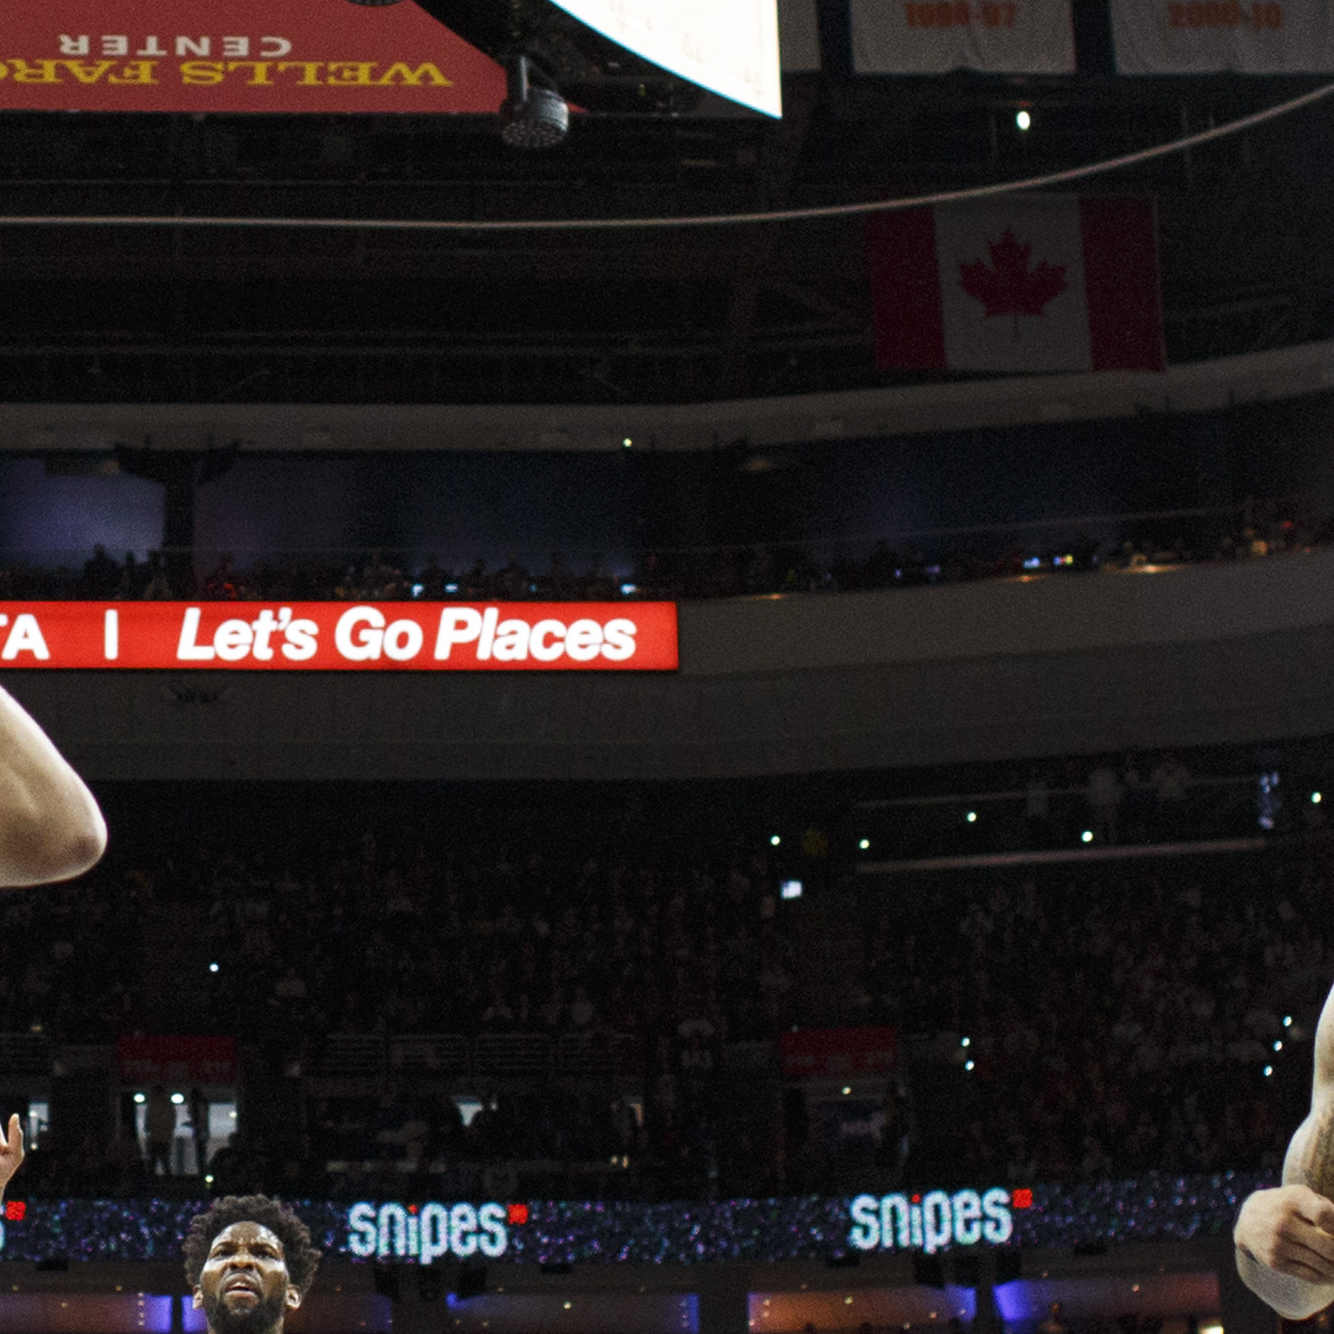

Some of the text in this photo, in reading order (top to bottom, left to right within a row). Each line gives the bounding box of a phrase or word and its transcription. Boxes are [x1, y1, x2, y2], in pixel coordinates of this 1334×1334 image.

[59, 34, 292, 57] CENTER
[180, 61, 454, 87] WELLS
[176, 605, 638, 661] Let's Go Places
[348, 1201, 508, 1265] snipes
[850, 1187, 1013, 1254] snipes
